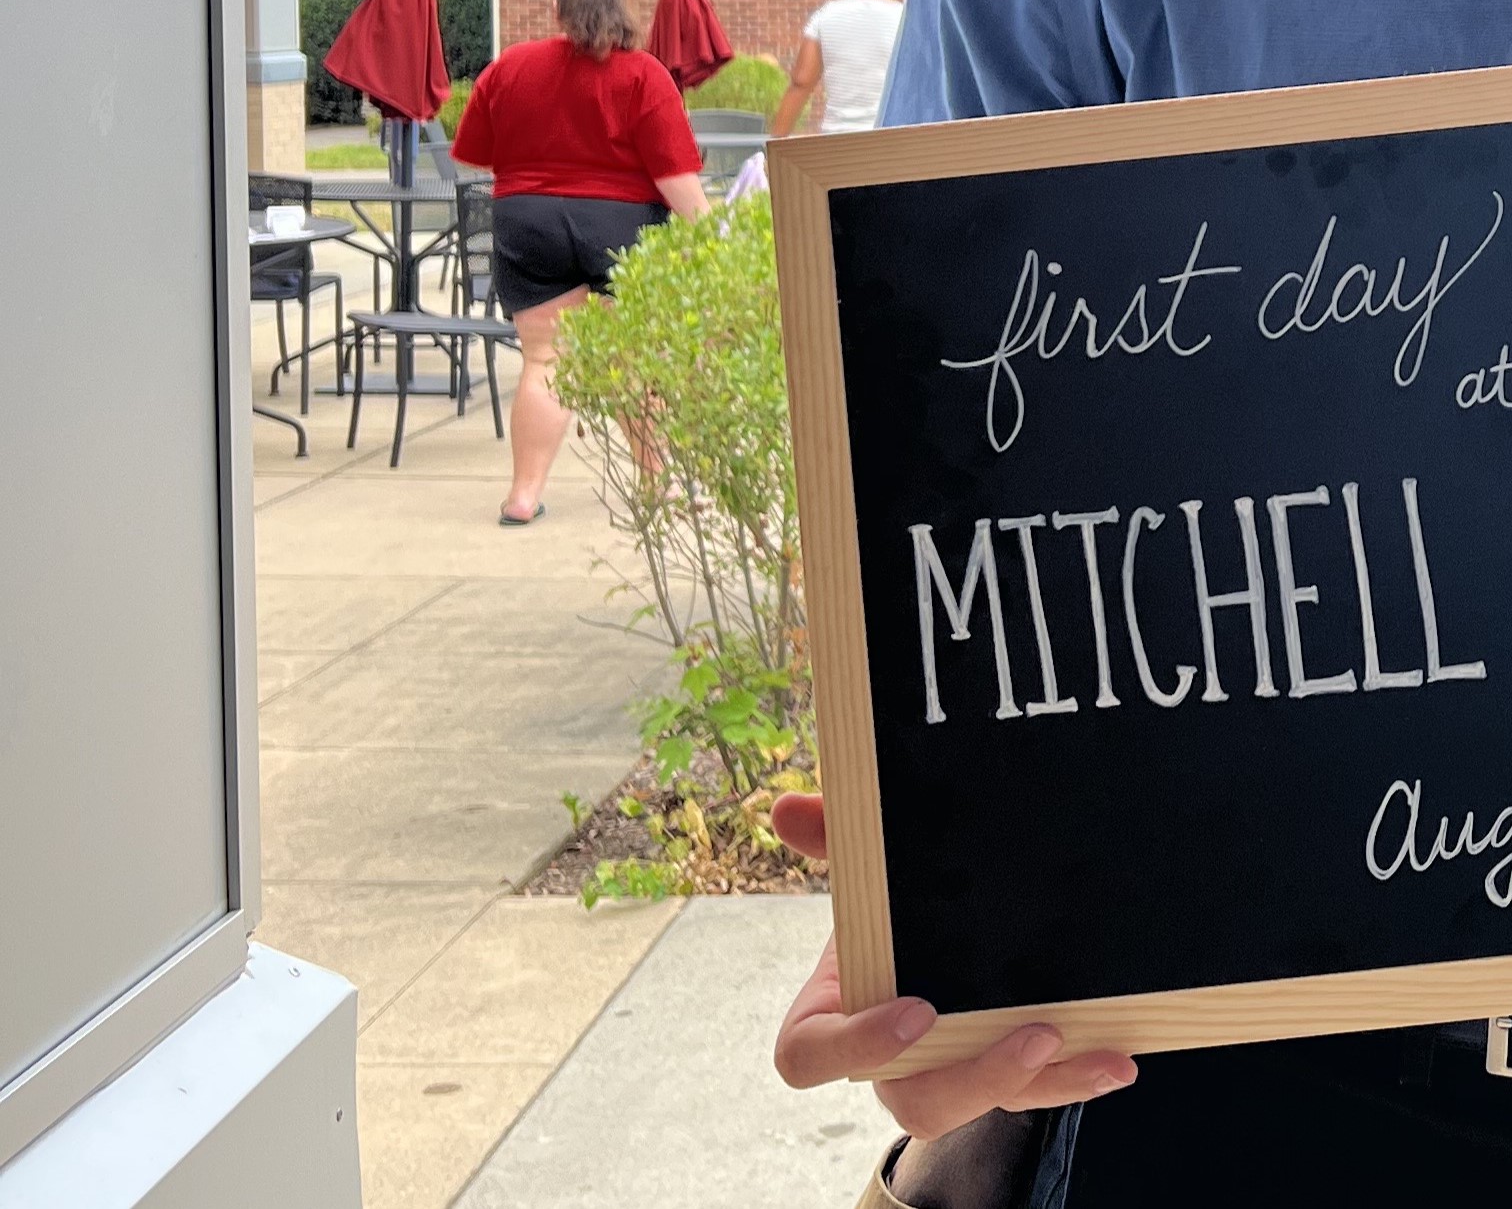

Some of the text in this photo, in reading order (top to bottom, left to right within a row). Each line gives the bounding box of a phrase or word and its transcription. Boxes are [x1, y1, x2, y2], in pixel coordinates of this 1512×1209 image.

[941, 221, 1242, 453] first
[1258, 189, 1504, 387] day
[908, 477, 1487, 724] MITCHELL
